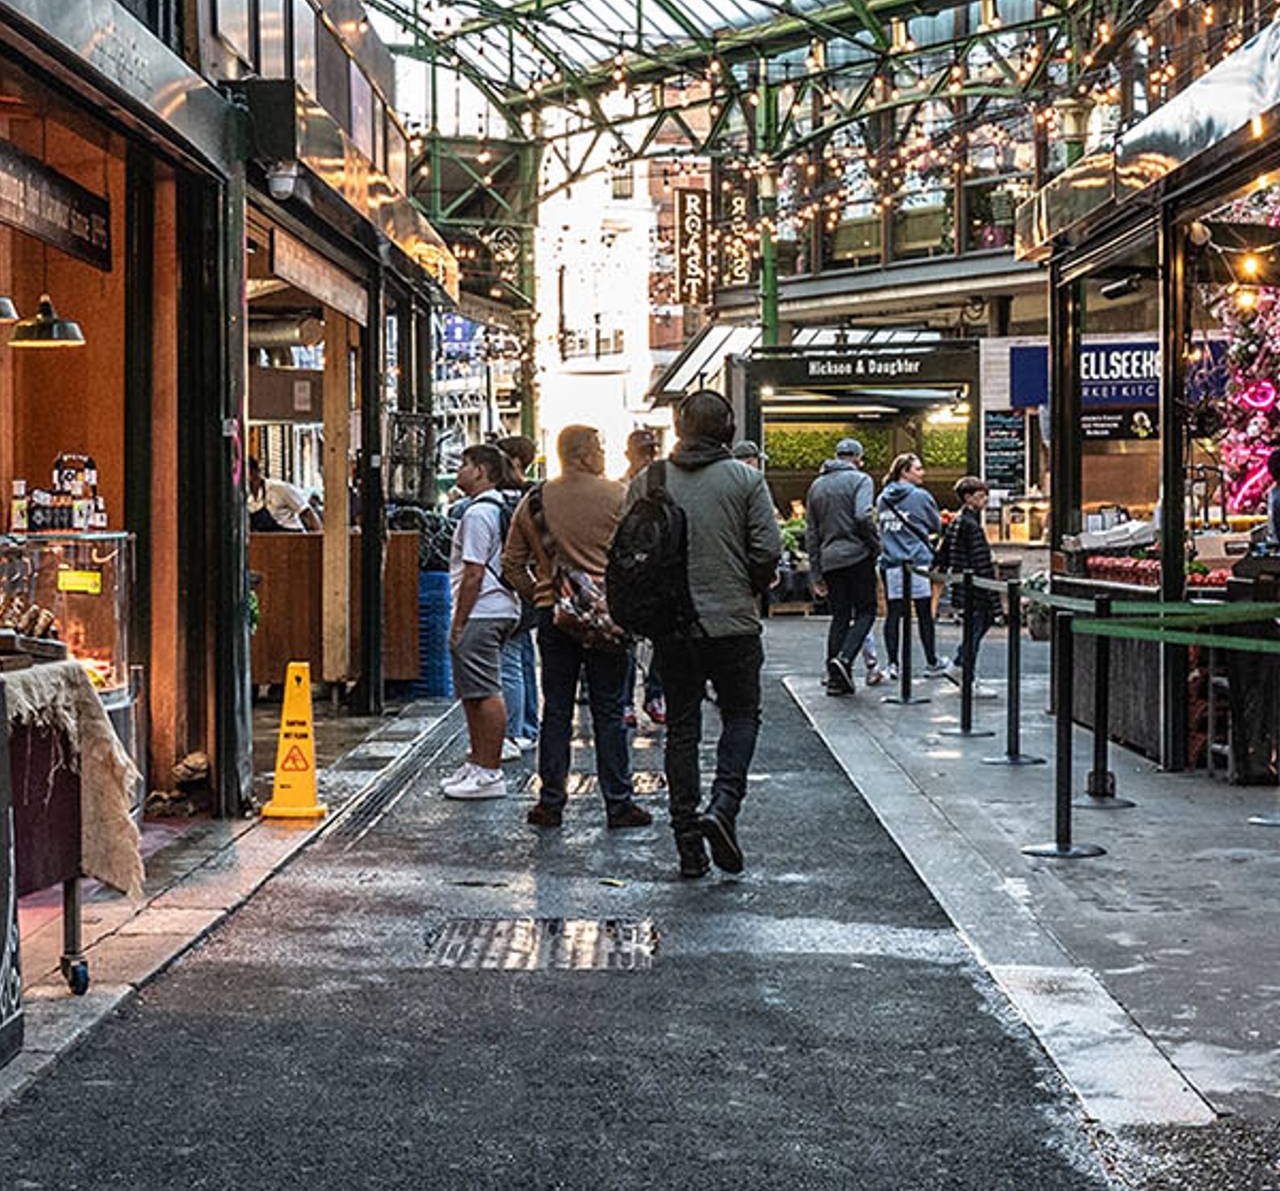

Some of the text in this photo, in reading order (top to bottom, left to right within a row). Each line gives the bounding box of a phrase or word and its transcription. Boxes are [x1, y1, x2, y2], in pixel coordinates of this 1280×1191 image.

[685, 194, 702, 298] ROAST
[855, 359, 865, 374] &
[868, 358, 920, 376] Daughter
